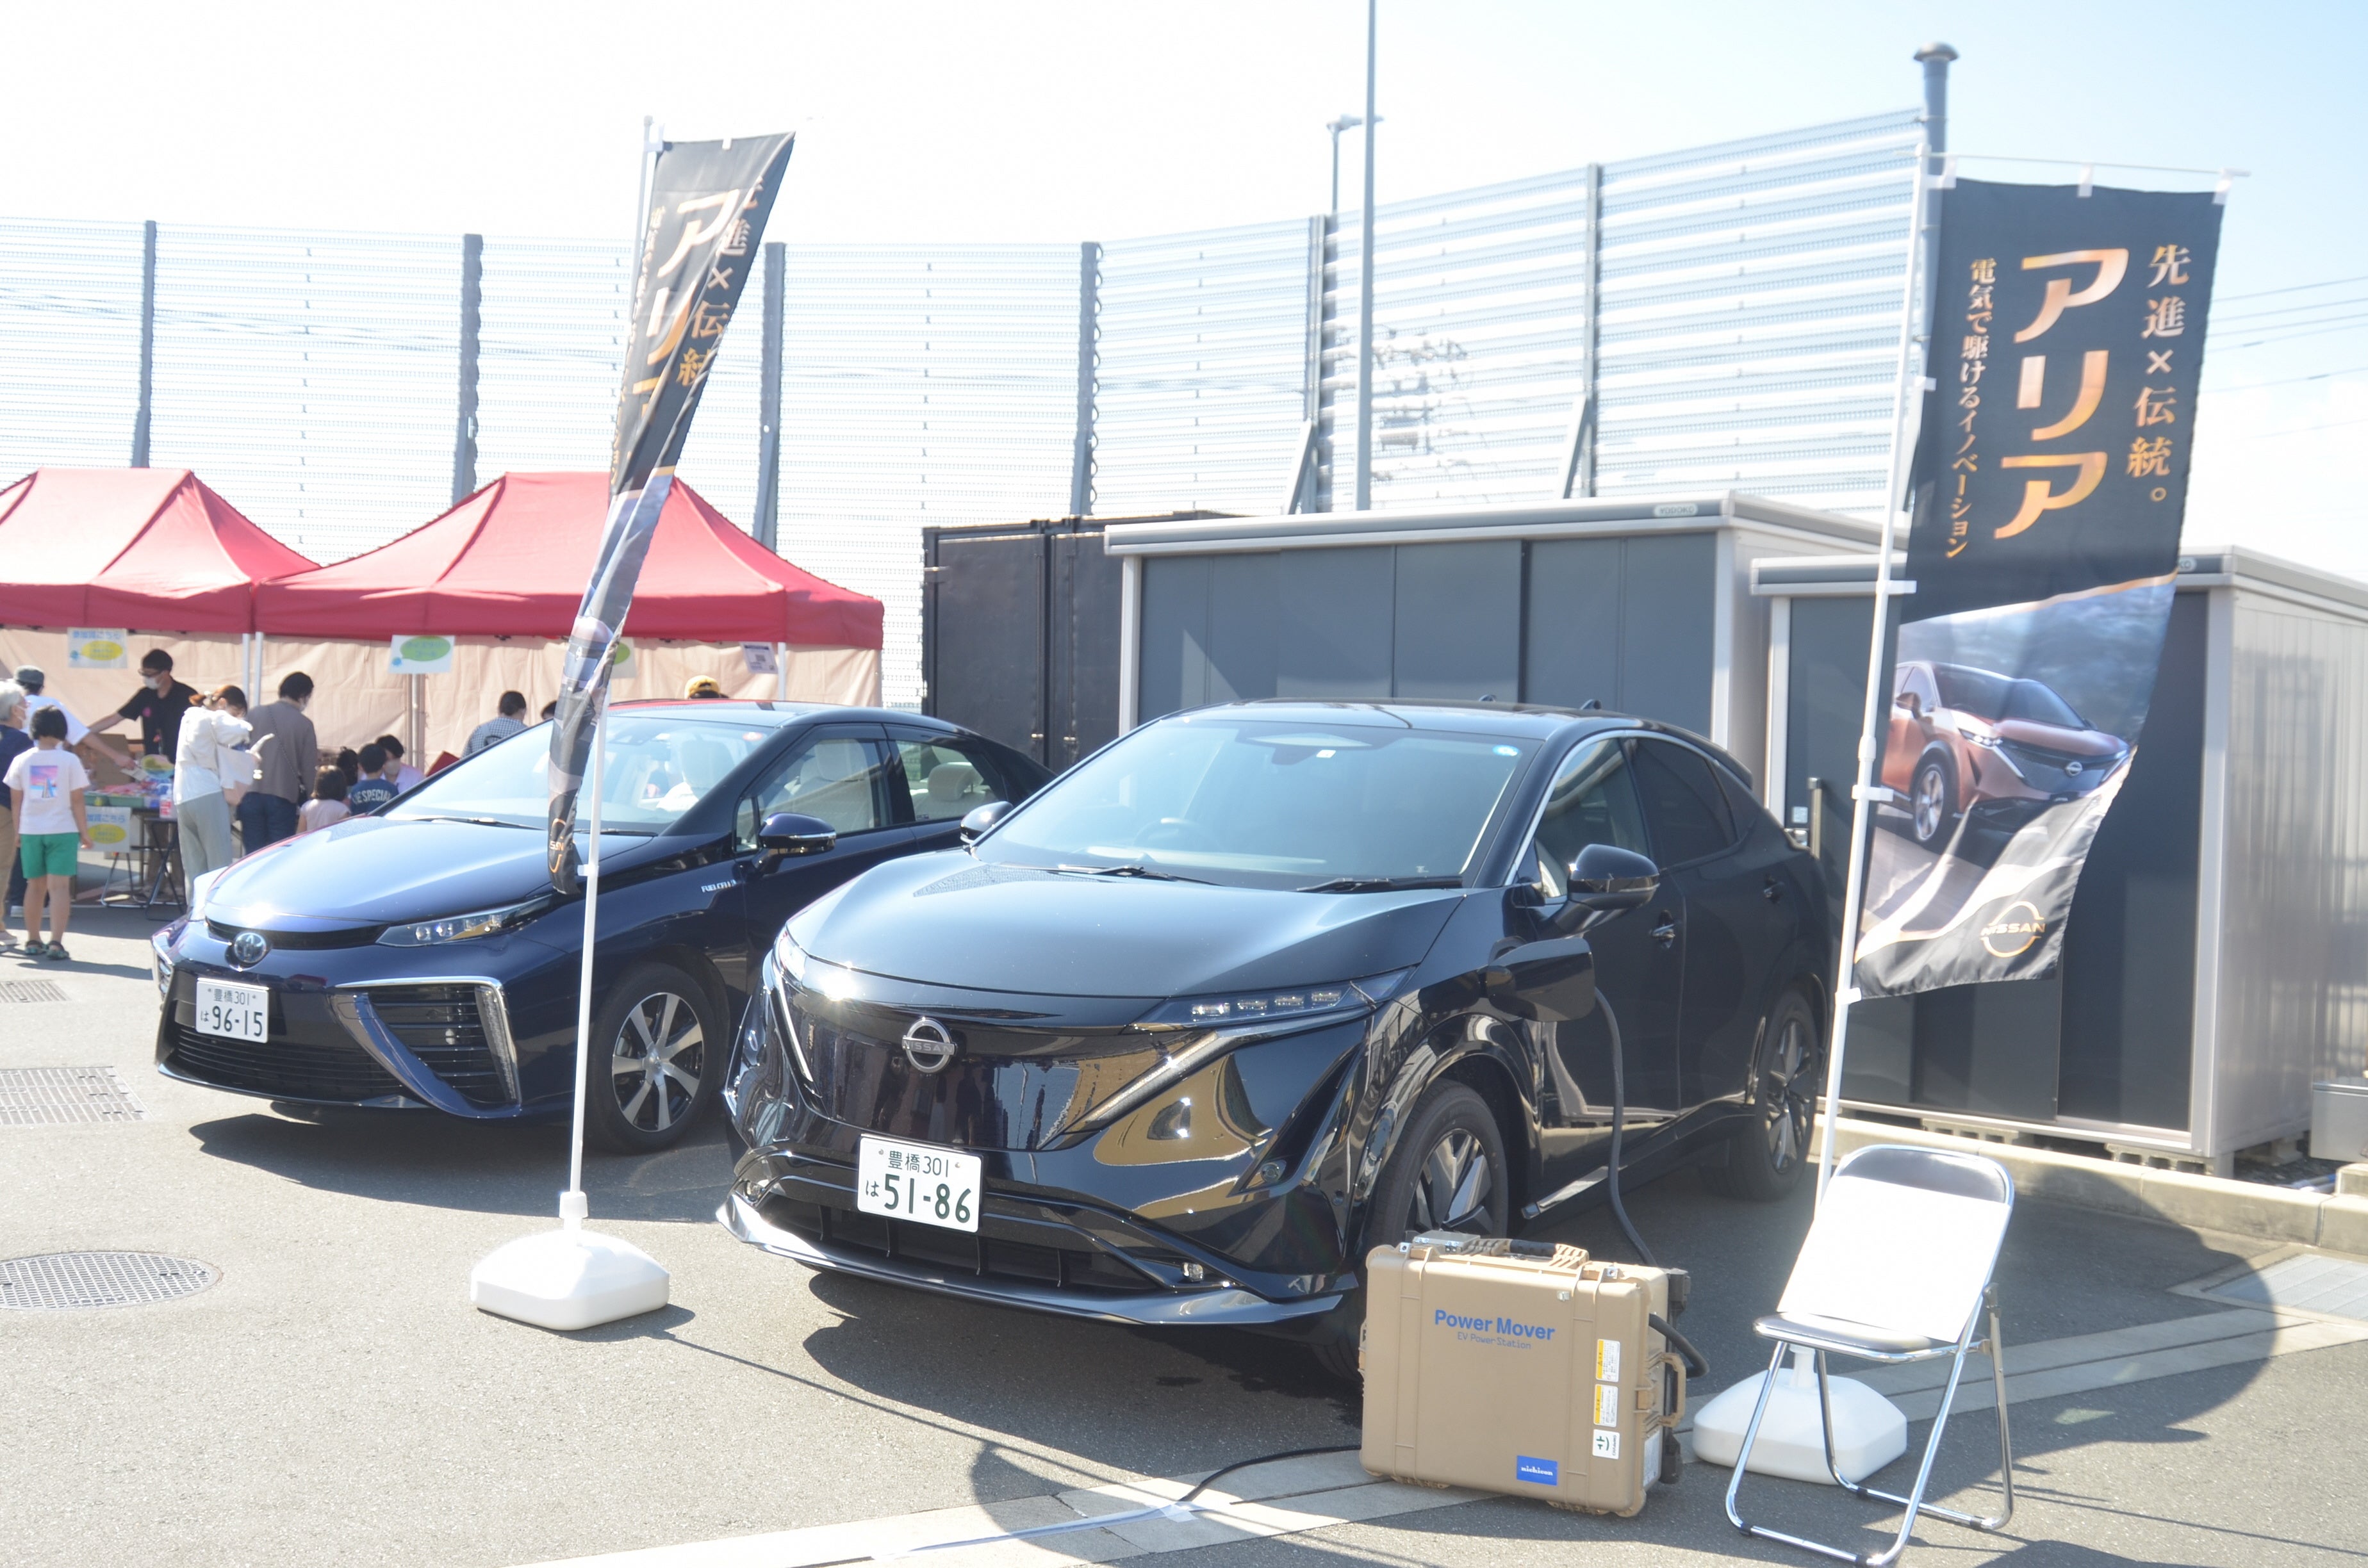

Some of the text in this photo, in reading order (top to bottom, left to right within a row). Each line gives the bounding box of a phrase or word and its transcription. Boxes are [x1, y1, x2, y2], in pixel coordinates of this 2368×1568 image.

[1945, 257, 1997, 559] 電気で駆けるイノベーション
[1994, 248, 2130, 539] アリア
[1980, 922, 2046, 936] NISSAN
[200, 1006, 263, 1037] は 96-15
[903, 1040, 953, 1054] NISSAN
[865, 1173, 972, 1223] は 51-86
[1435, 1309, 1556, 1341] Power Mover
[1458, 1332, 1532, 1350] EV Power Station
[1521, 1465, 1554, 1476] nichicon
